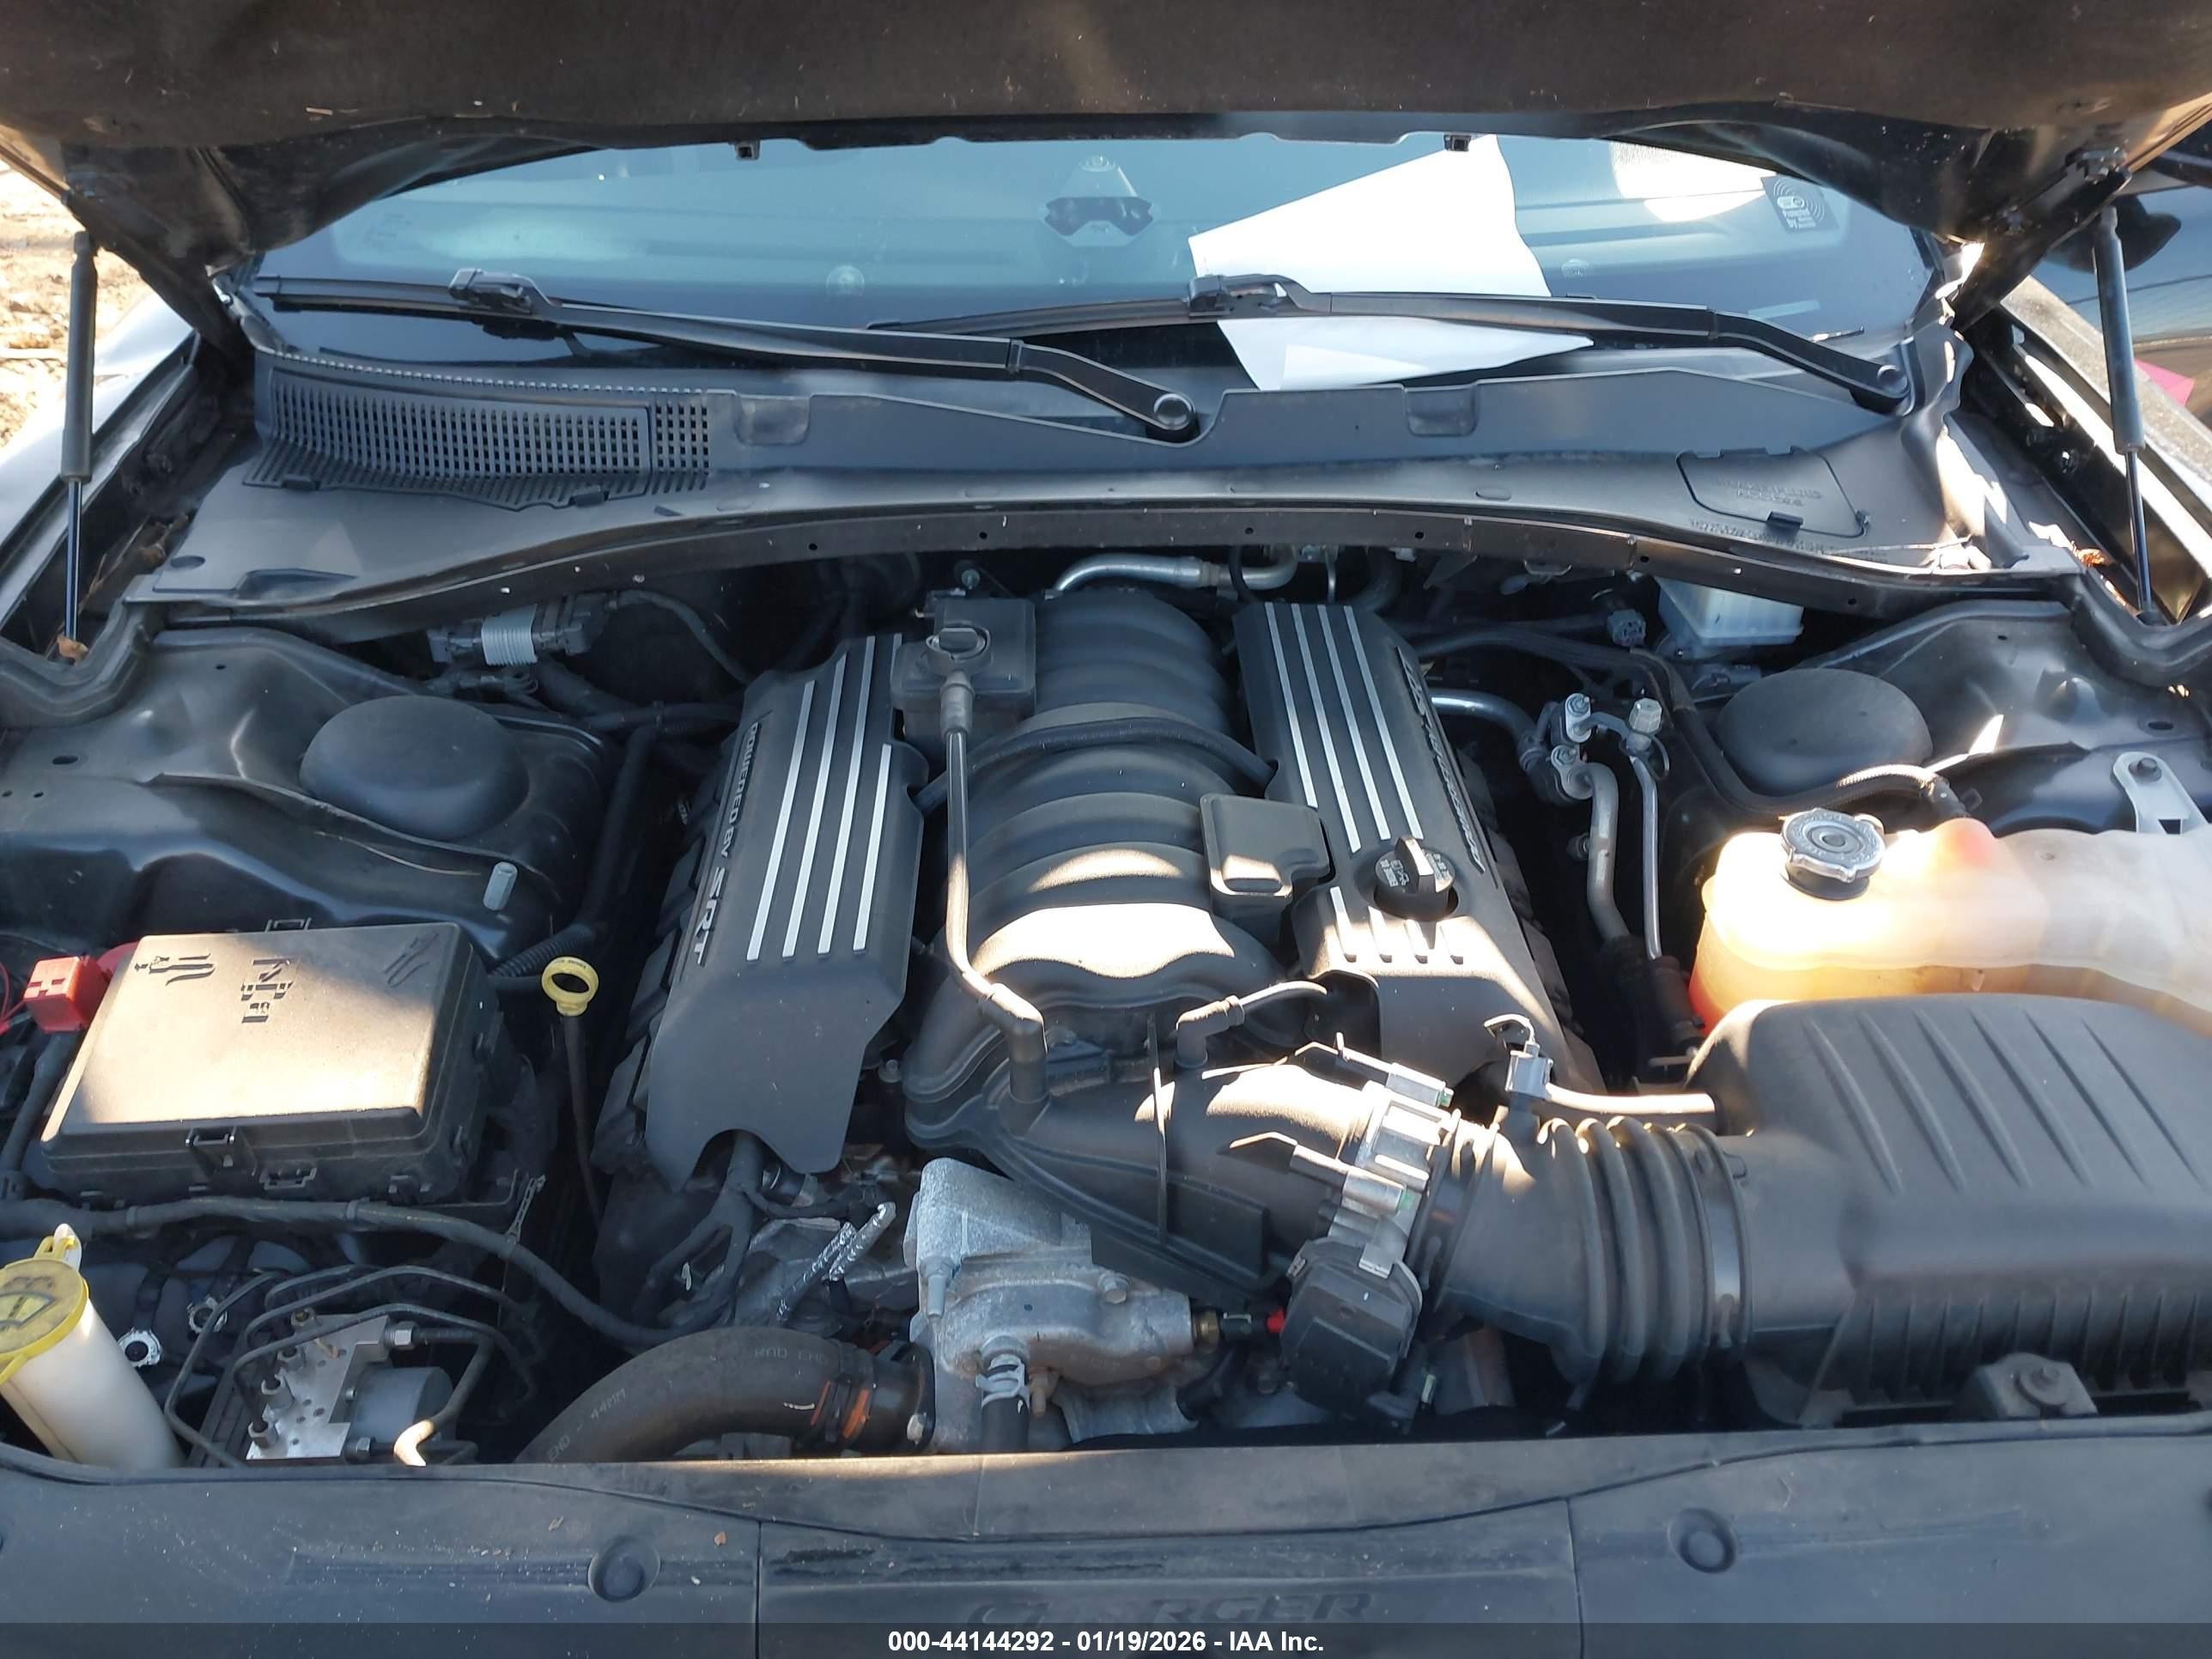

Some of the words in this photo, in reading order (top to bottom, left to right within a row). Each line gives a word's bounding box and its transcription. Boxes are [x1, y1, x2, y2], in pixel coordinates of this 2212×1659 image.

[728, 721, 760, 823] POWERED
[721, 826, 735, 858] BY
[694, 866, 726, 964] SRT
